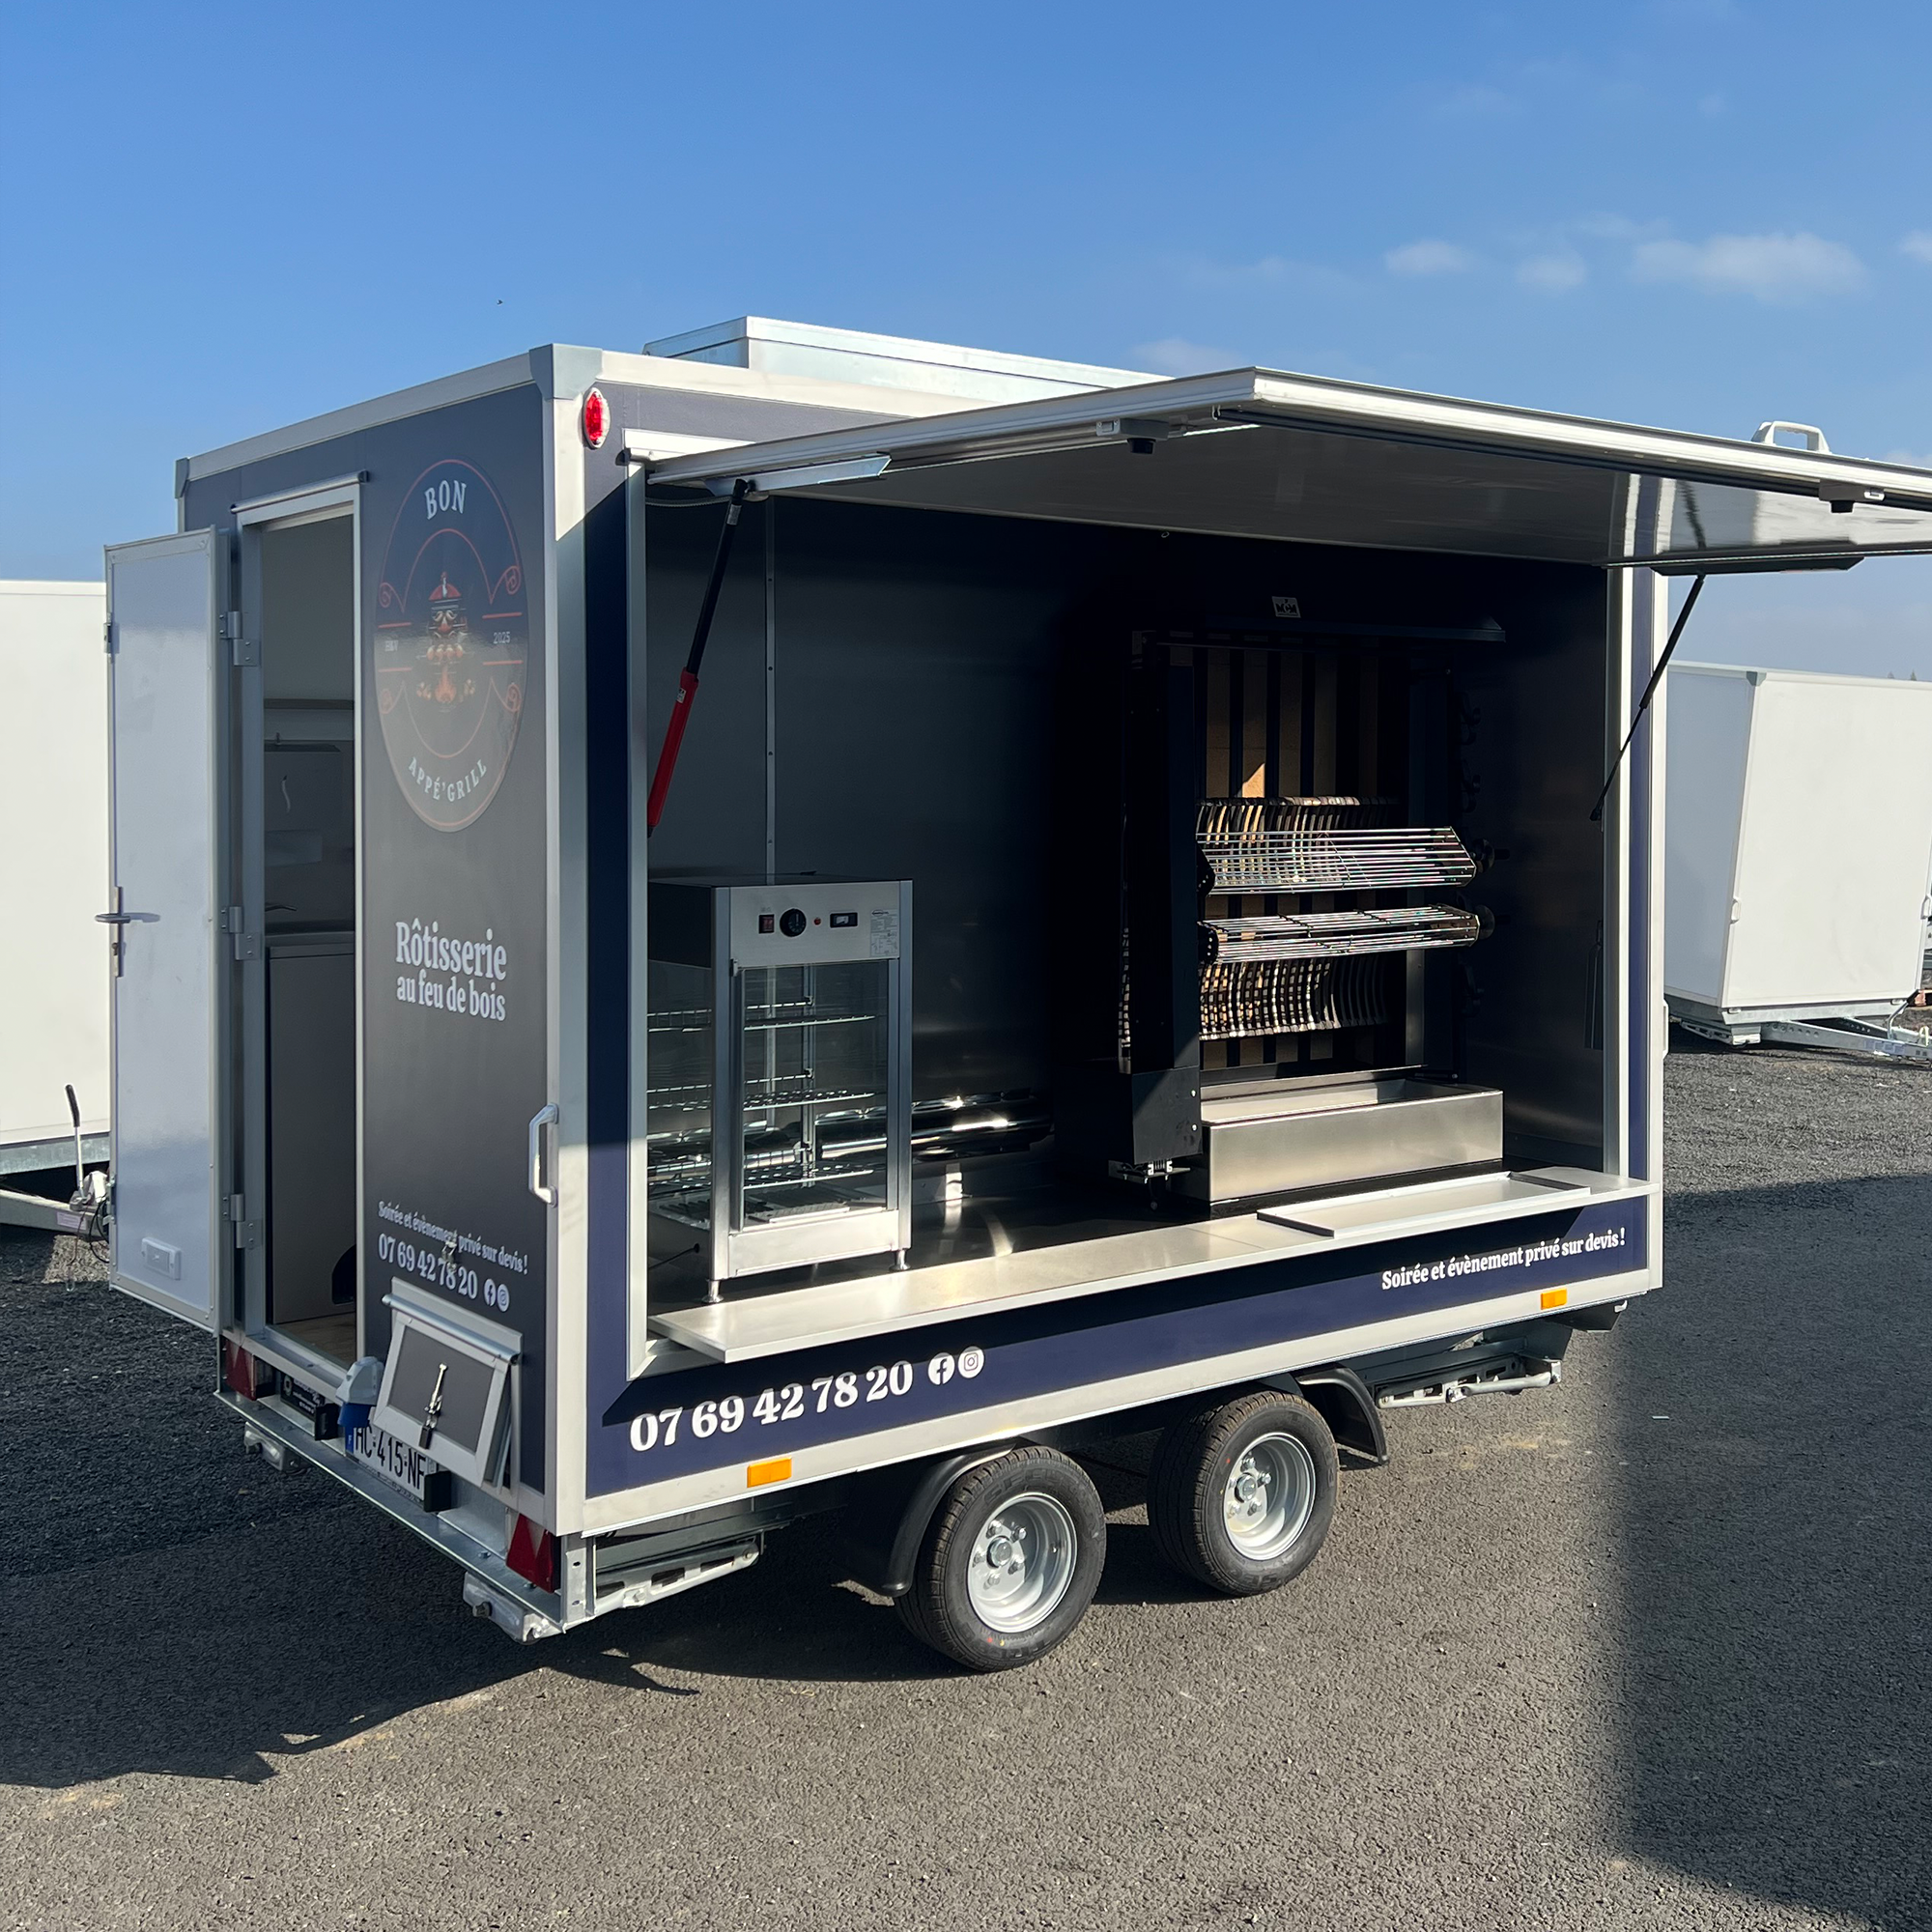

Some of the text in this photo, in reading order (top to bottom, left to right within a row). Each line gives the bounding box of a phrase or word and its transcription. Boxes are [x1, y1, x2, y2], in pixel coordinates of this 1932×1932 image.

[424, 480, 467, 520] BON
[395, 917, 507, 980] Rôtisserie
[396, 968, 506, 1021] au feu de bois
[378, 1201, 403, 1226] Soirée
[403, 1211, 412, 1229] et
[458, 1233, 481, 1255] privé
[482, 1244, 497, 1263] sur
[378, 1233, 478, 1299] 07 69 42 78 20
[1381, 1263, 1429, 1291] Soirée
[1431, 1261, 1445, 1281] et
[1447, 1247, 1523, 1278] évènement
[1524, 1236, 1560, 1267] privé
[1561, 1239, 1584, 1257] sur
[629, 1360, 914, 1453] 07 69 42 78 20
